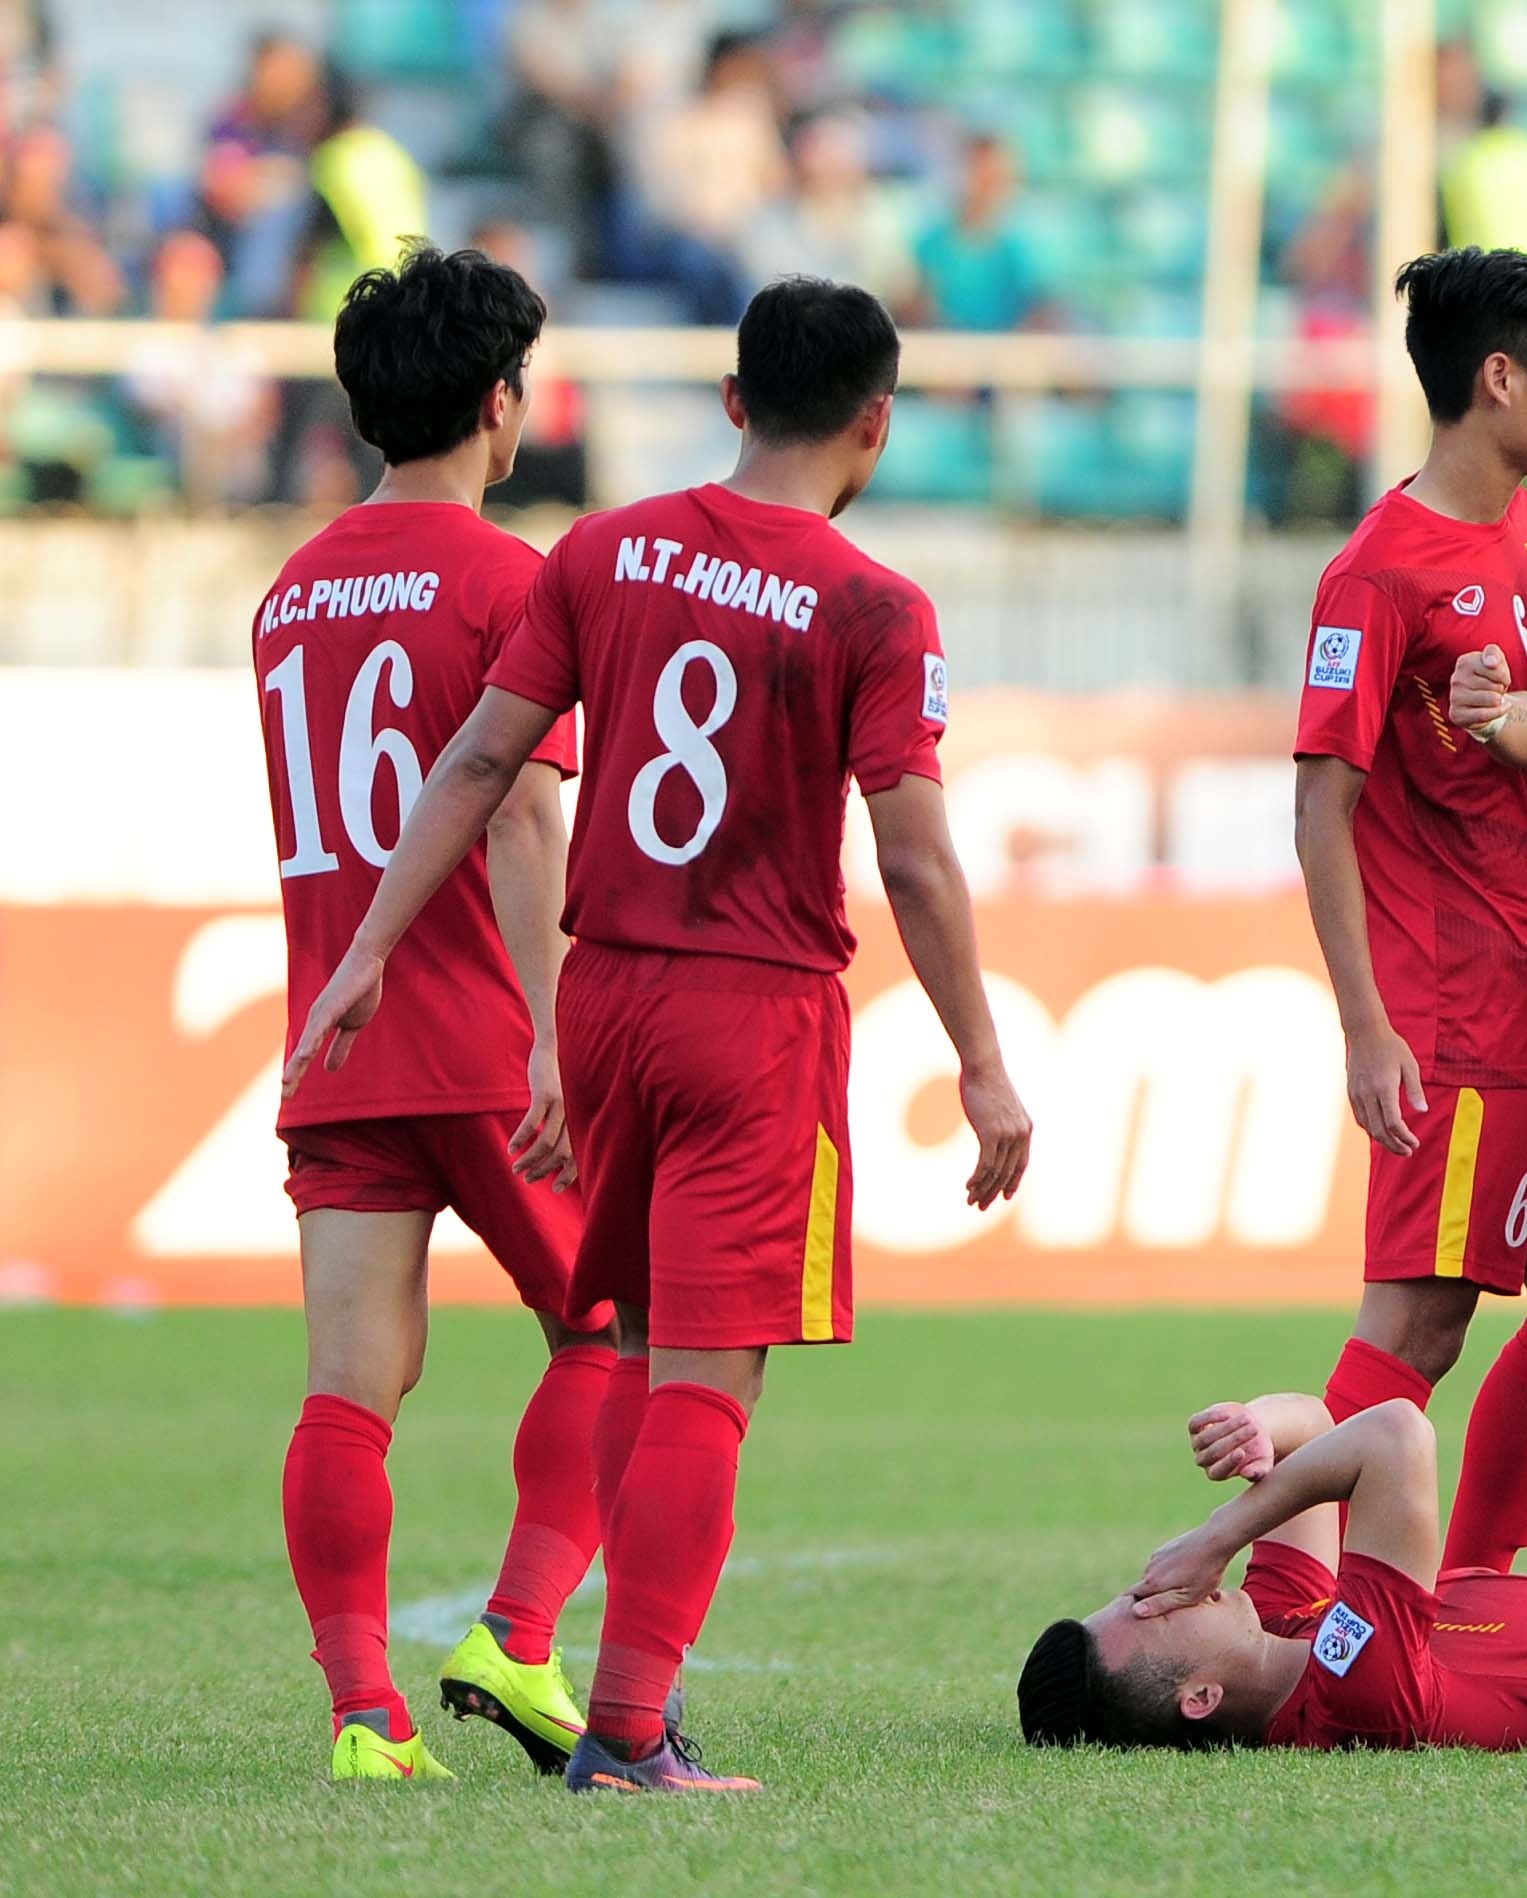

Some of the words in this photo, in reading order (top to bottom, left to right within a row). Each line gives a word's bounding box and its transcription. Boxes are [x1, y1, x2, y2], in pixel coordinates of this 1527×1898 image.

[259, 571, 440, 639] N.C.PHUONG
[615, 536, 818, 632] N.T.HOANG
[264, 639, 425, 879] 16
[628, 640, 737, 866] 8
